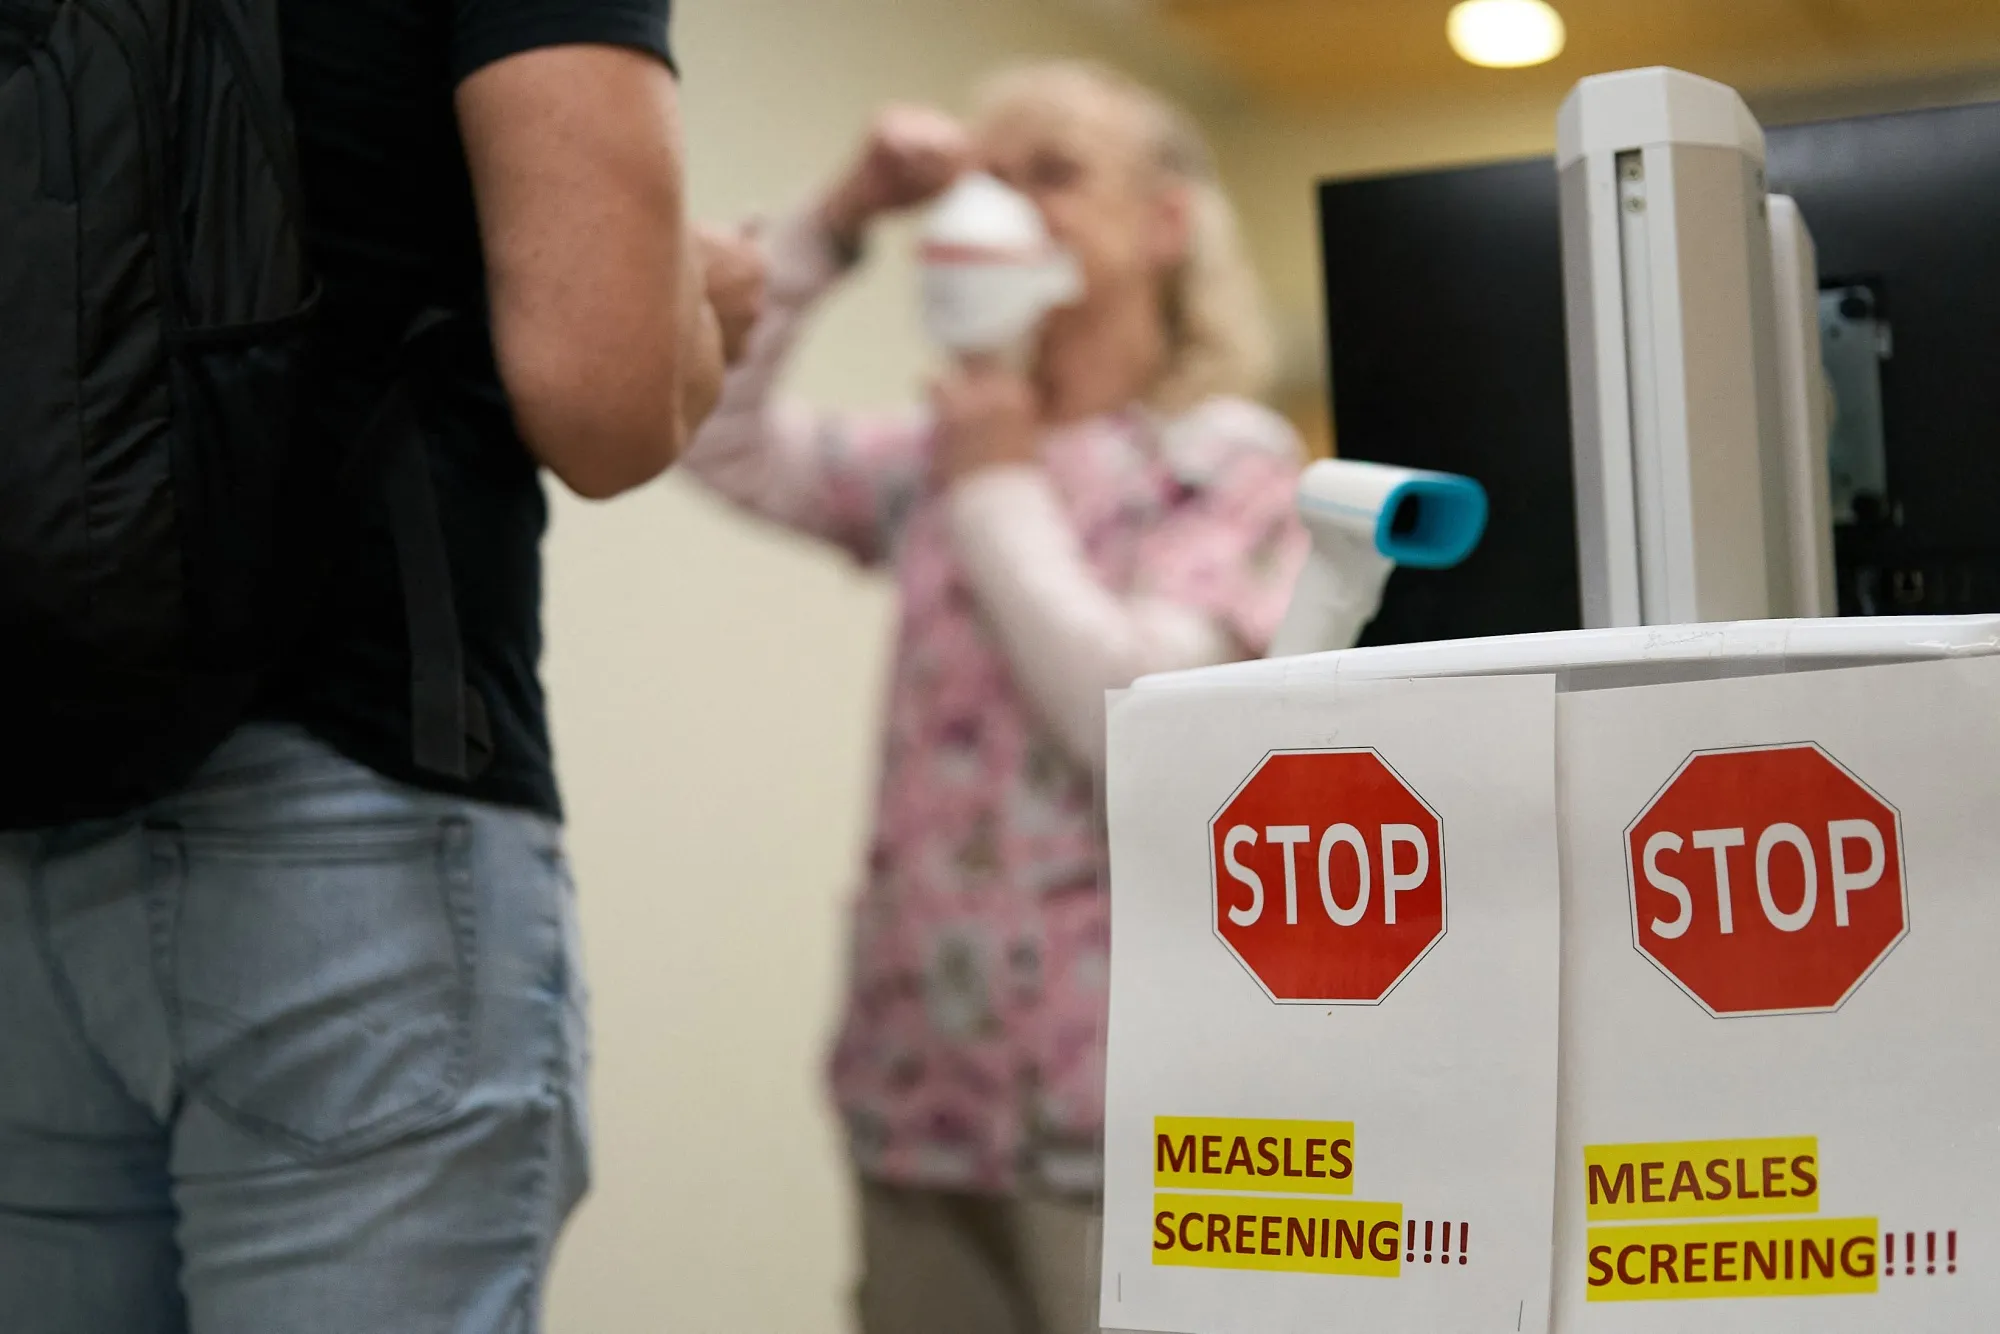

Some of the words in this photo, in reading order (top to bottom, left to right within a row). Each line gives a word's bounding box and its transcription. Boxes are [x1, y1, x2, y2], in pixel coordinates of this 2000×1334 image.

[1223, 822, 1430, 928] STOP
[1642, 818, 1887, 940] STOP
[1156, 1133, 1354, 1180] MEASLES
[1587, 1154, 1818, 1206] MEASLES
[1153, 1211, 1470, 1266] SCREENING!!!!
[1586, 1230, 1959, 1287] SCREENING!!!!
